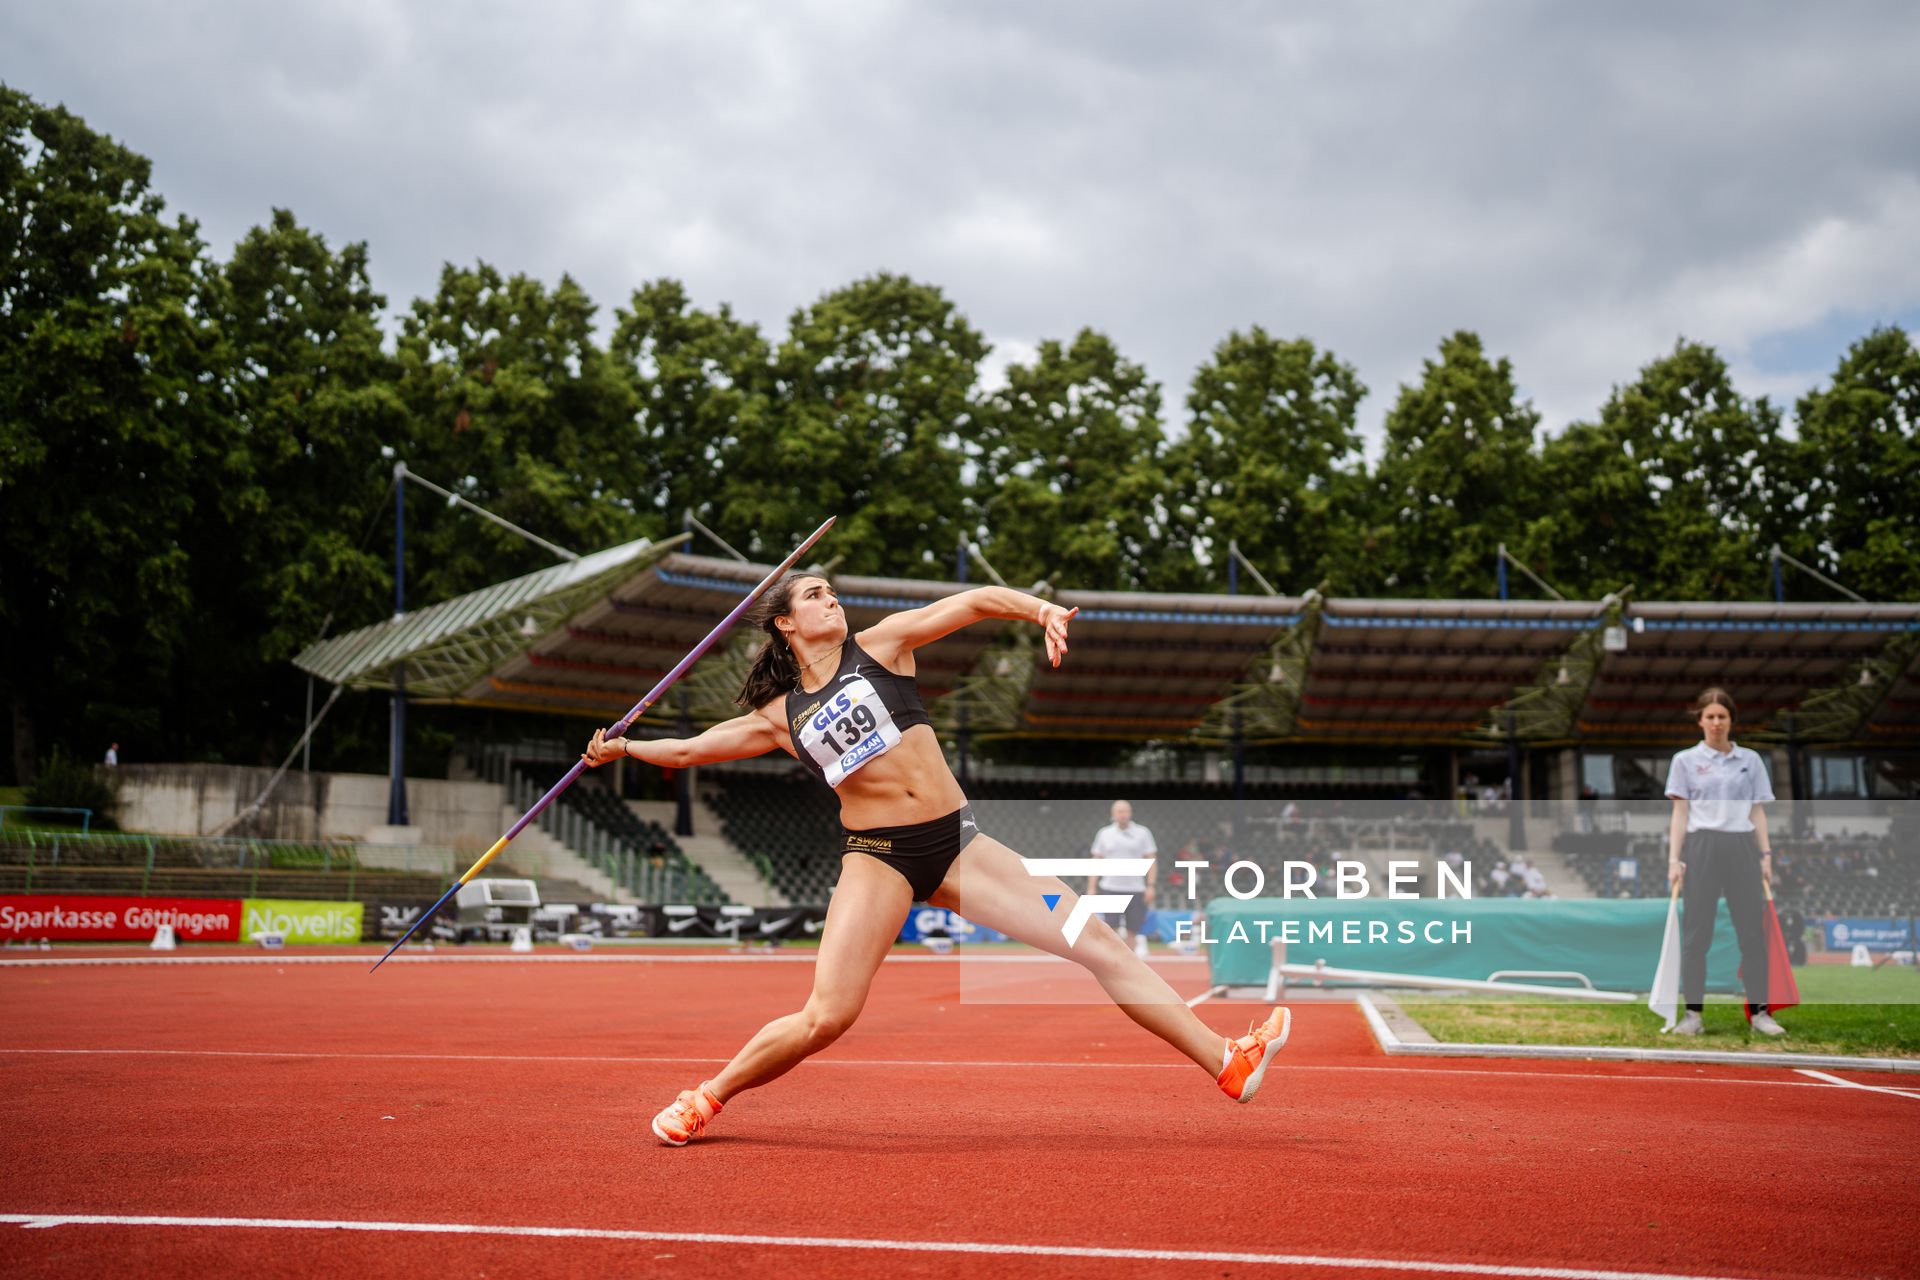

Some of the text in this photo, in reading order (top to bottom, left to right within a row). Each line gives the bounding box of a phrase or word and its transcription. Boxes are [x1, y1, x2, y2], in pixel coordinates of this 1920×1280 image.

[820, 704, 877, 757] 139
[857, 735, 881, 755] PLAN
[0, 905, 229, 935] Sparkasse Göttingen
[249, 909, 356, 939] Novelis
